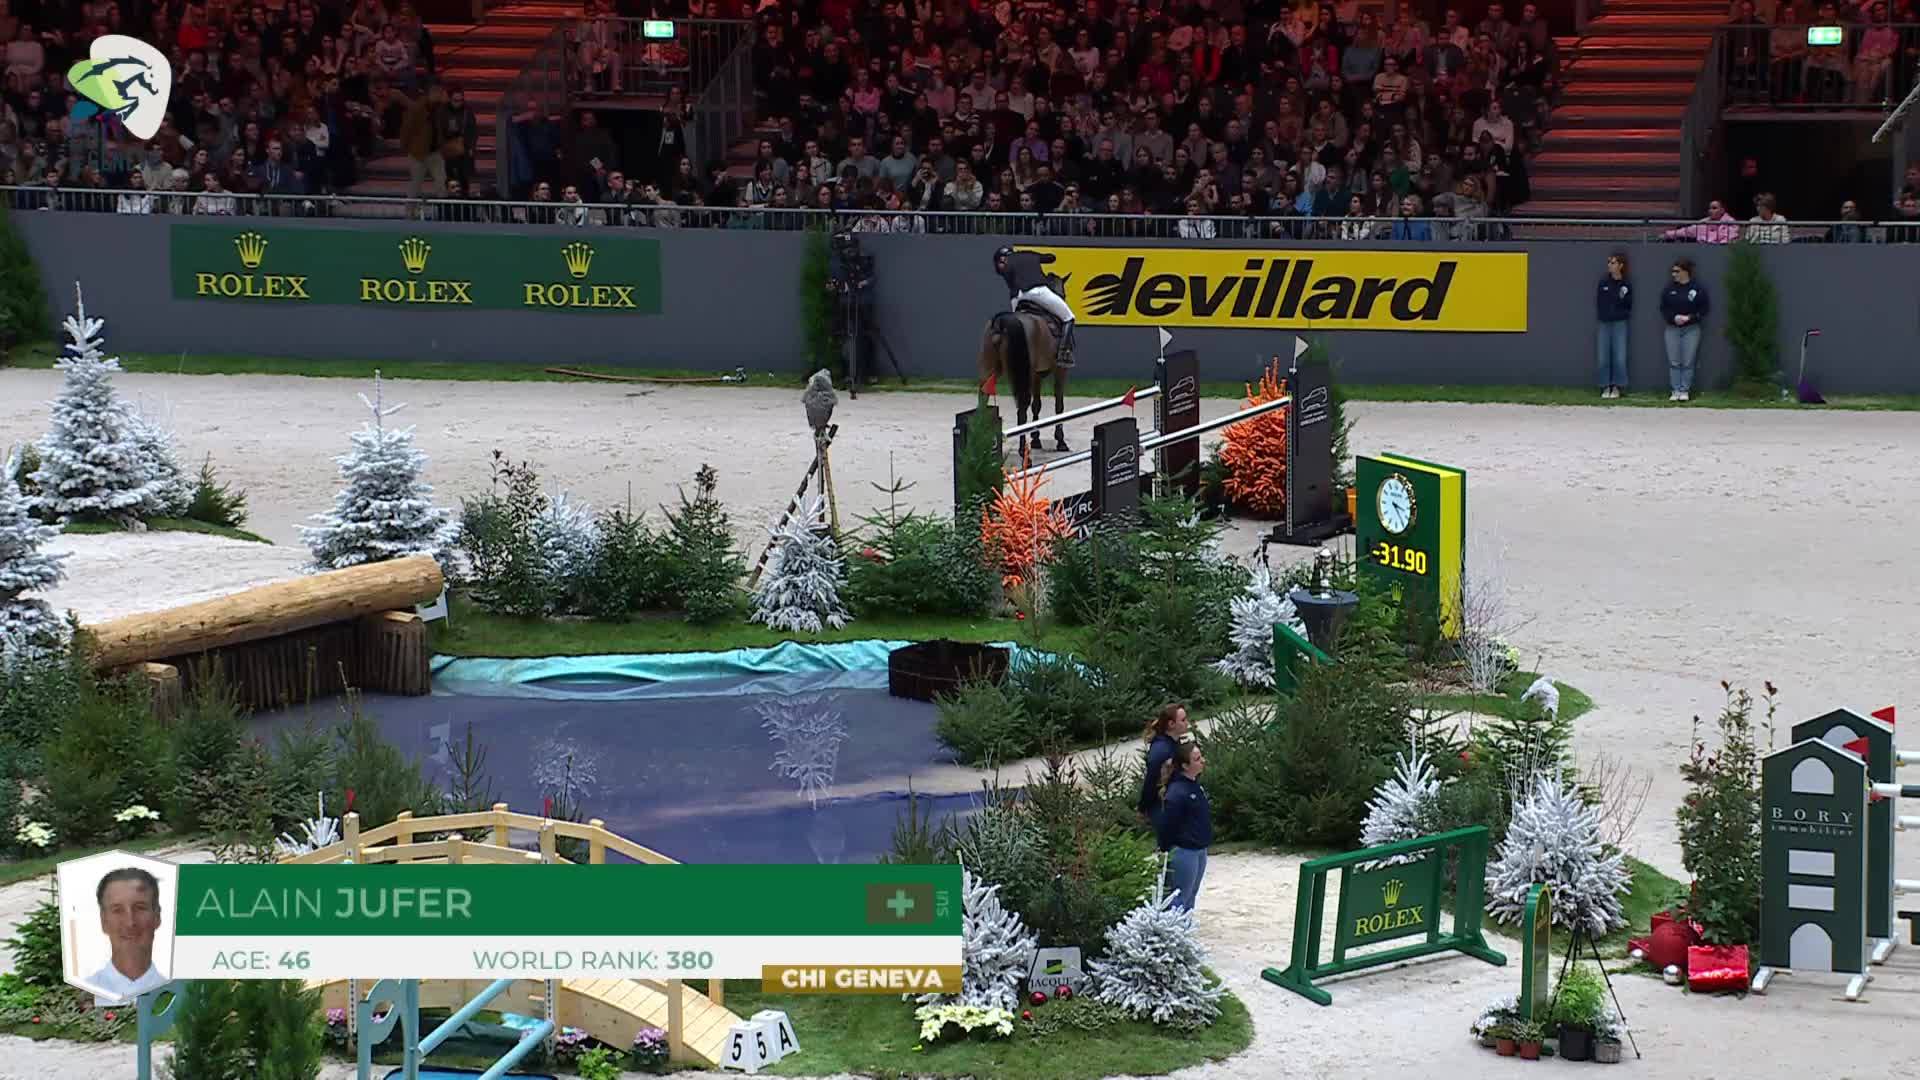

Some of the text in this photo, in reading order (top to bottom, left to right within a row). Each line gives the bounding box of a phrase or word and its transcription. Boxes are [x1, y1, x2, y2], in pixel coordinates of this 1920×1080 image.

[196, 273, 308, 299] ROLEX
[360, 279, 471, 304] ROLEX
[524, 284, 636, 308] ROLEX
[1082, 256, 1458, 322] devillard
[1372, 542, 1427, 575] -31.90
[1771, 807, 1854, 824] BORY
[1770, 824, 1854, 837] immobilier
[1354, 905, 1424, 937] ROLEX
[1030, 976, 1078, 988] JACQUE
[732, 1033, 743, 1062] 5
[756, 1031, 767, 1060] 5
[778, 1021, 793, 1051] A
